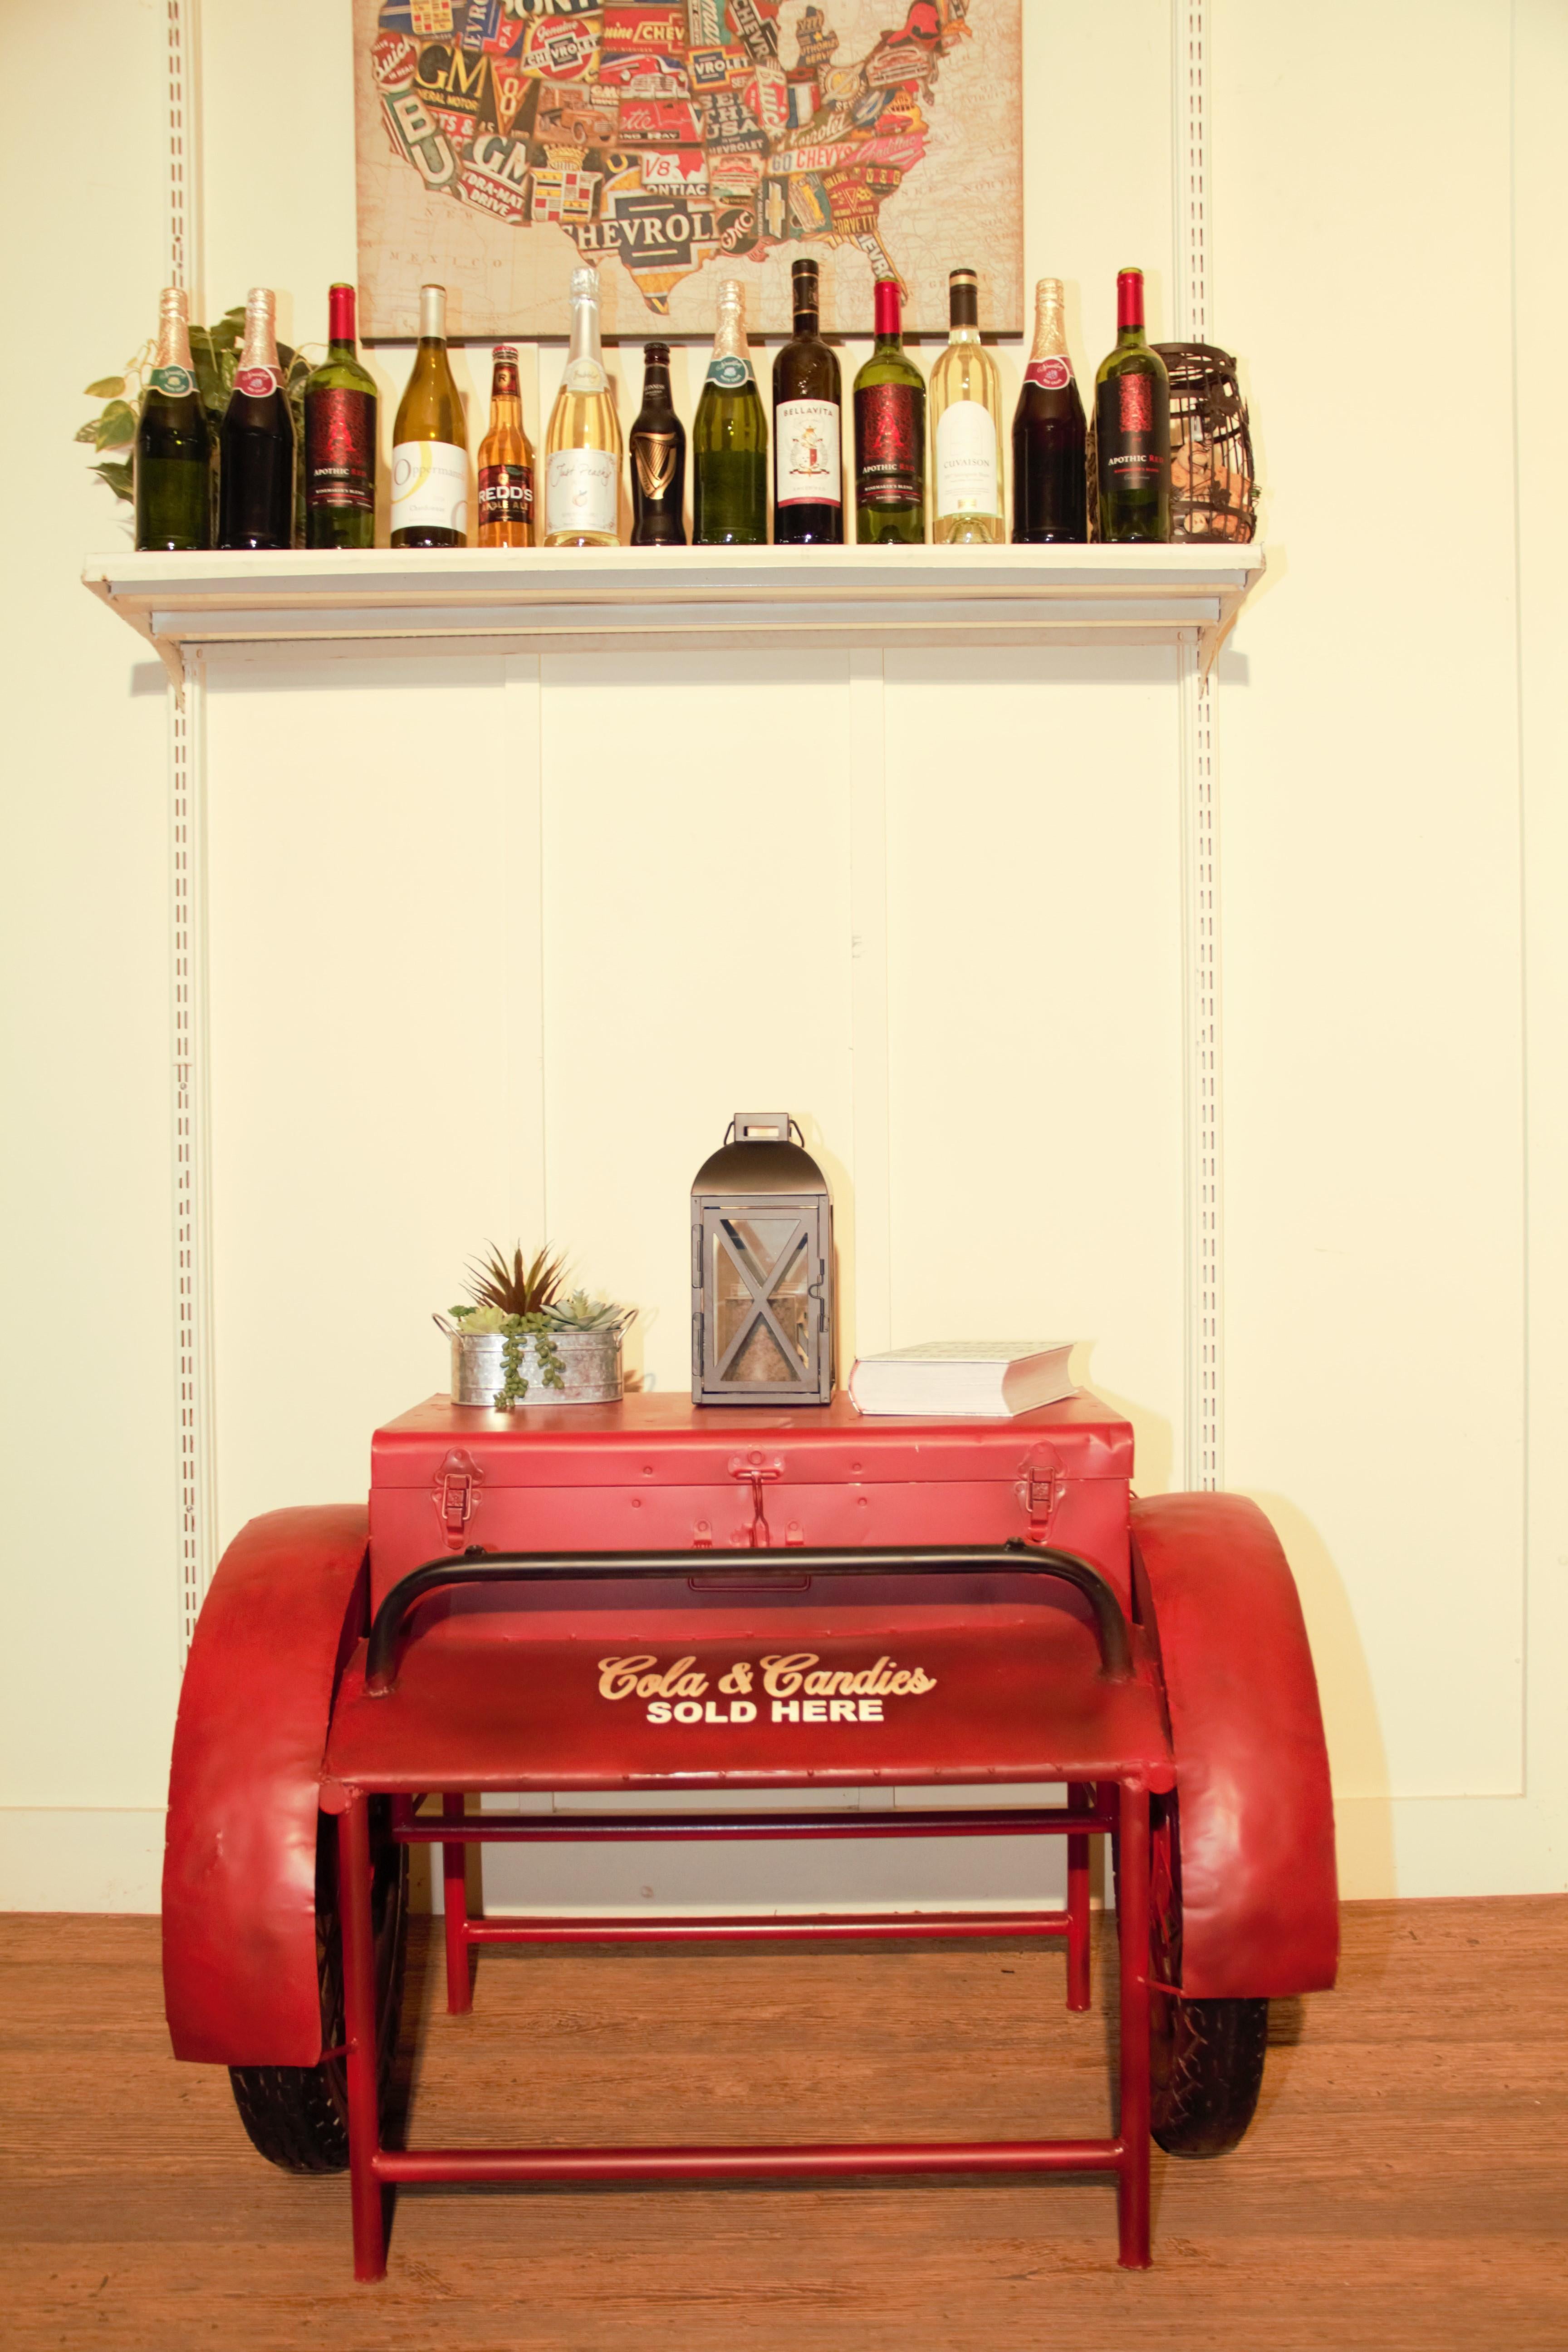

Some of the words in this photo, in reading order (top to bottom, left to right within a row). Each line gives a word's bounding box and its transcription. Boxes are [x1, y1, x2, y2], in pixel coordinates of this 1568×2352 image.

[537, 20, 578, 43] Genuine
[414, 41, 489, 98] GM
[470, 188, 510, 216] DRIVE
[721, 211, 754, 250] GMC
[783, 407, 833, 417] BELLAVITA
[862, 464, 898, 474] APOTHIC
[944, 459, 990, 469] CUVAISON
[1108, 455, 1147, 466] APOTHIC
[314, 468, 350, 477] APOTHIC
[478, 485, 533, 504] REDDS
[598, 1655, 710, 1700] Cola
[718, 1662, 754, 1695] &
[760, 1653, 937, 1698] Candies
[646, 1700, 757, 1724] SOLD
[771, 1699, 884, 1723] HERE
